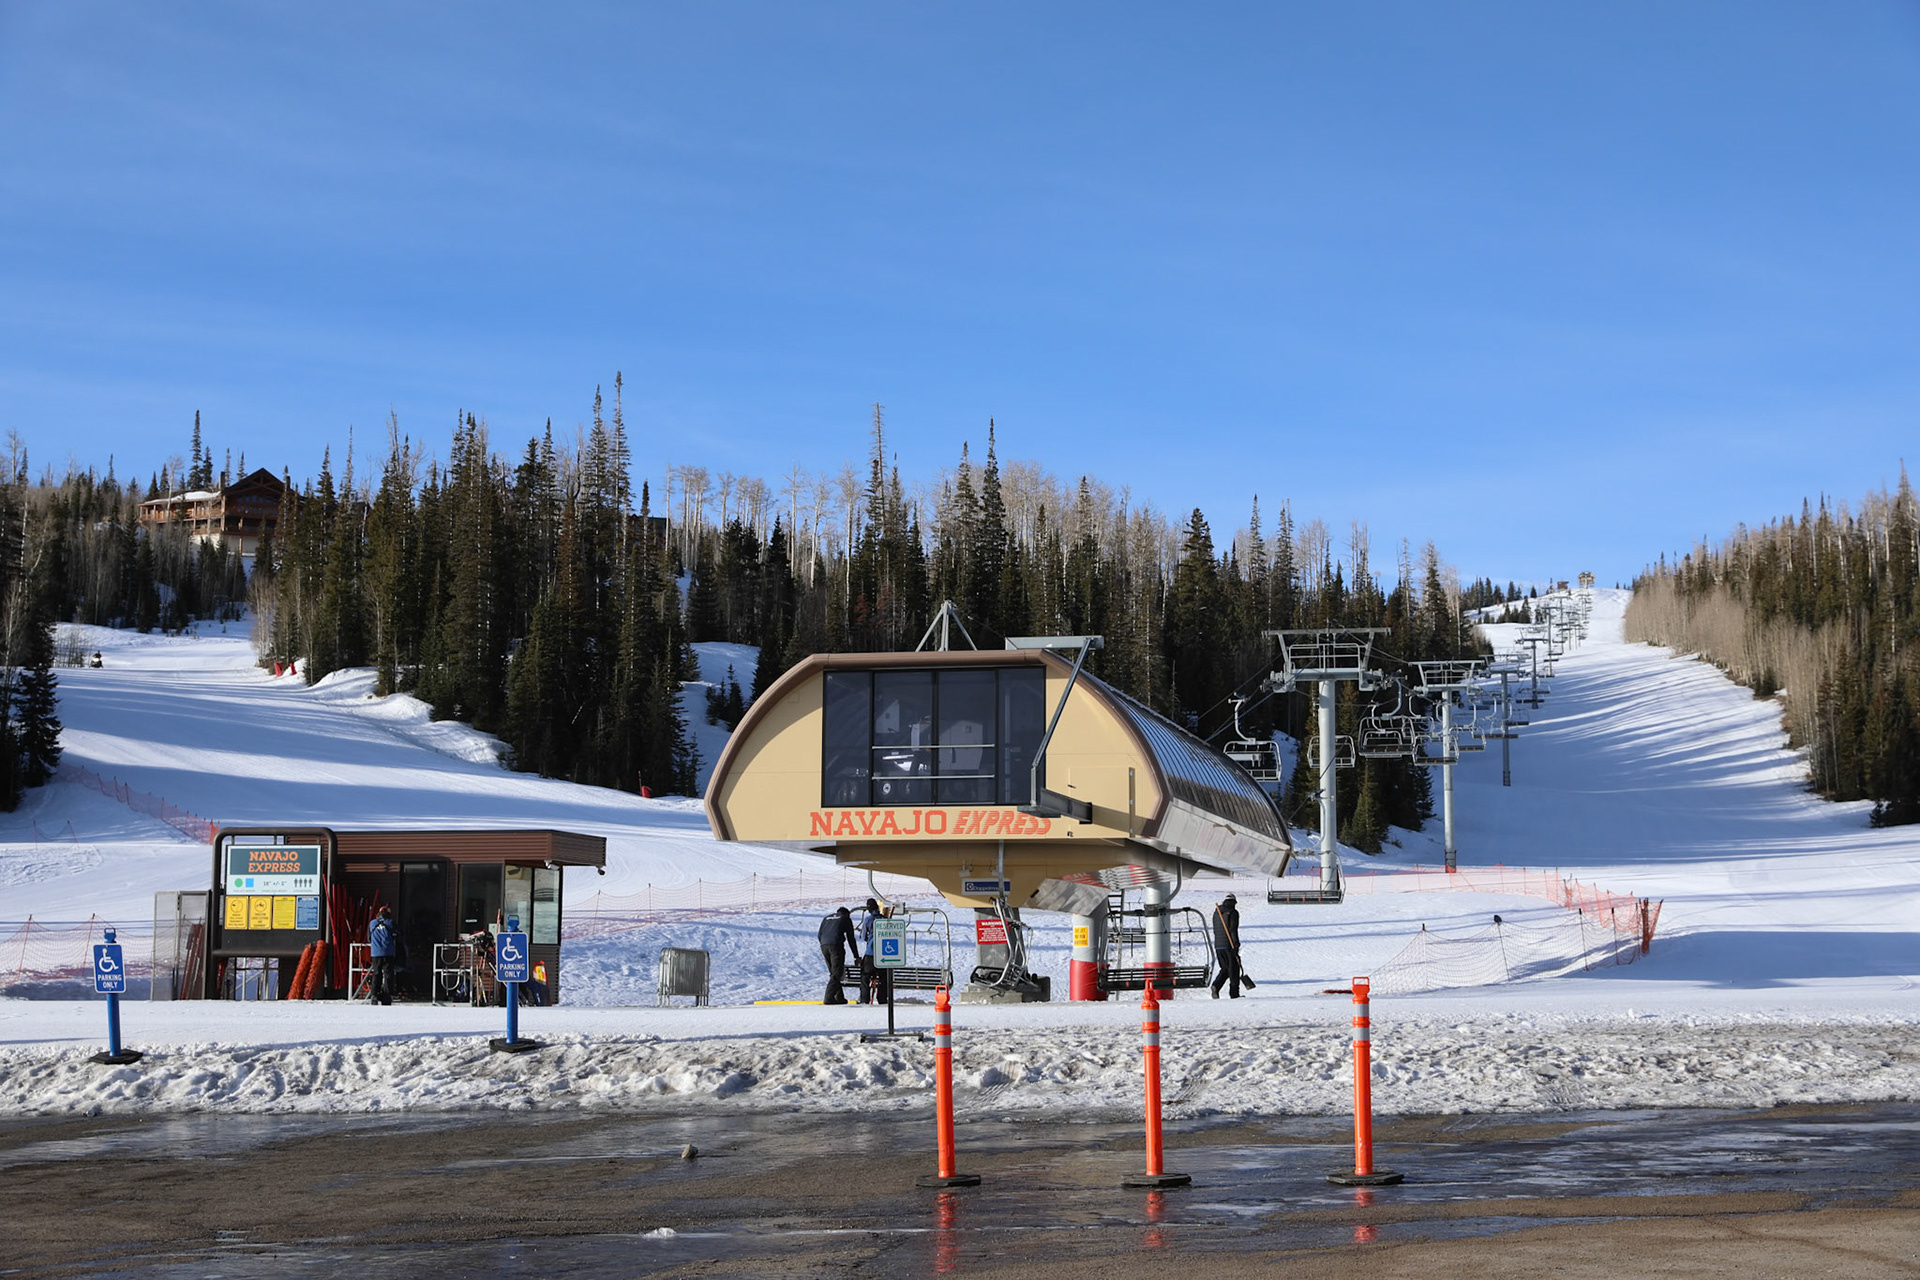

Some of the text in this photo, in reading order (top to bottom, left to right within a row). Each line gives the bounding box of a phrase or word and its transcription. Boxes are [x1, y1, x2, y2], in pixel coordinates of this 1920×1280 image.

[810, 809, 1051, 836] NAVAJO EXPRESS
[249, 851, 298, 861] NAVAJO
[248, 862, 300, 872] EXPRESS
